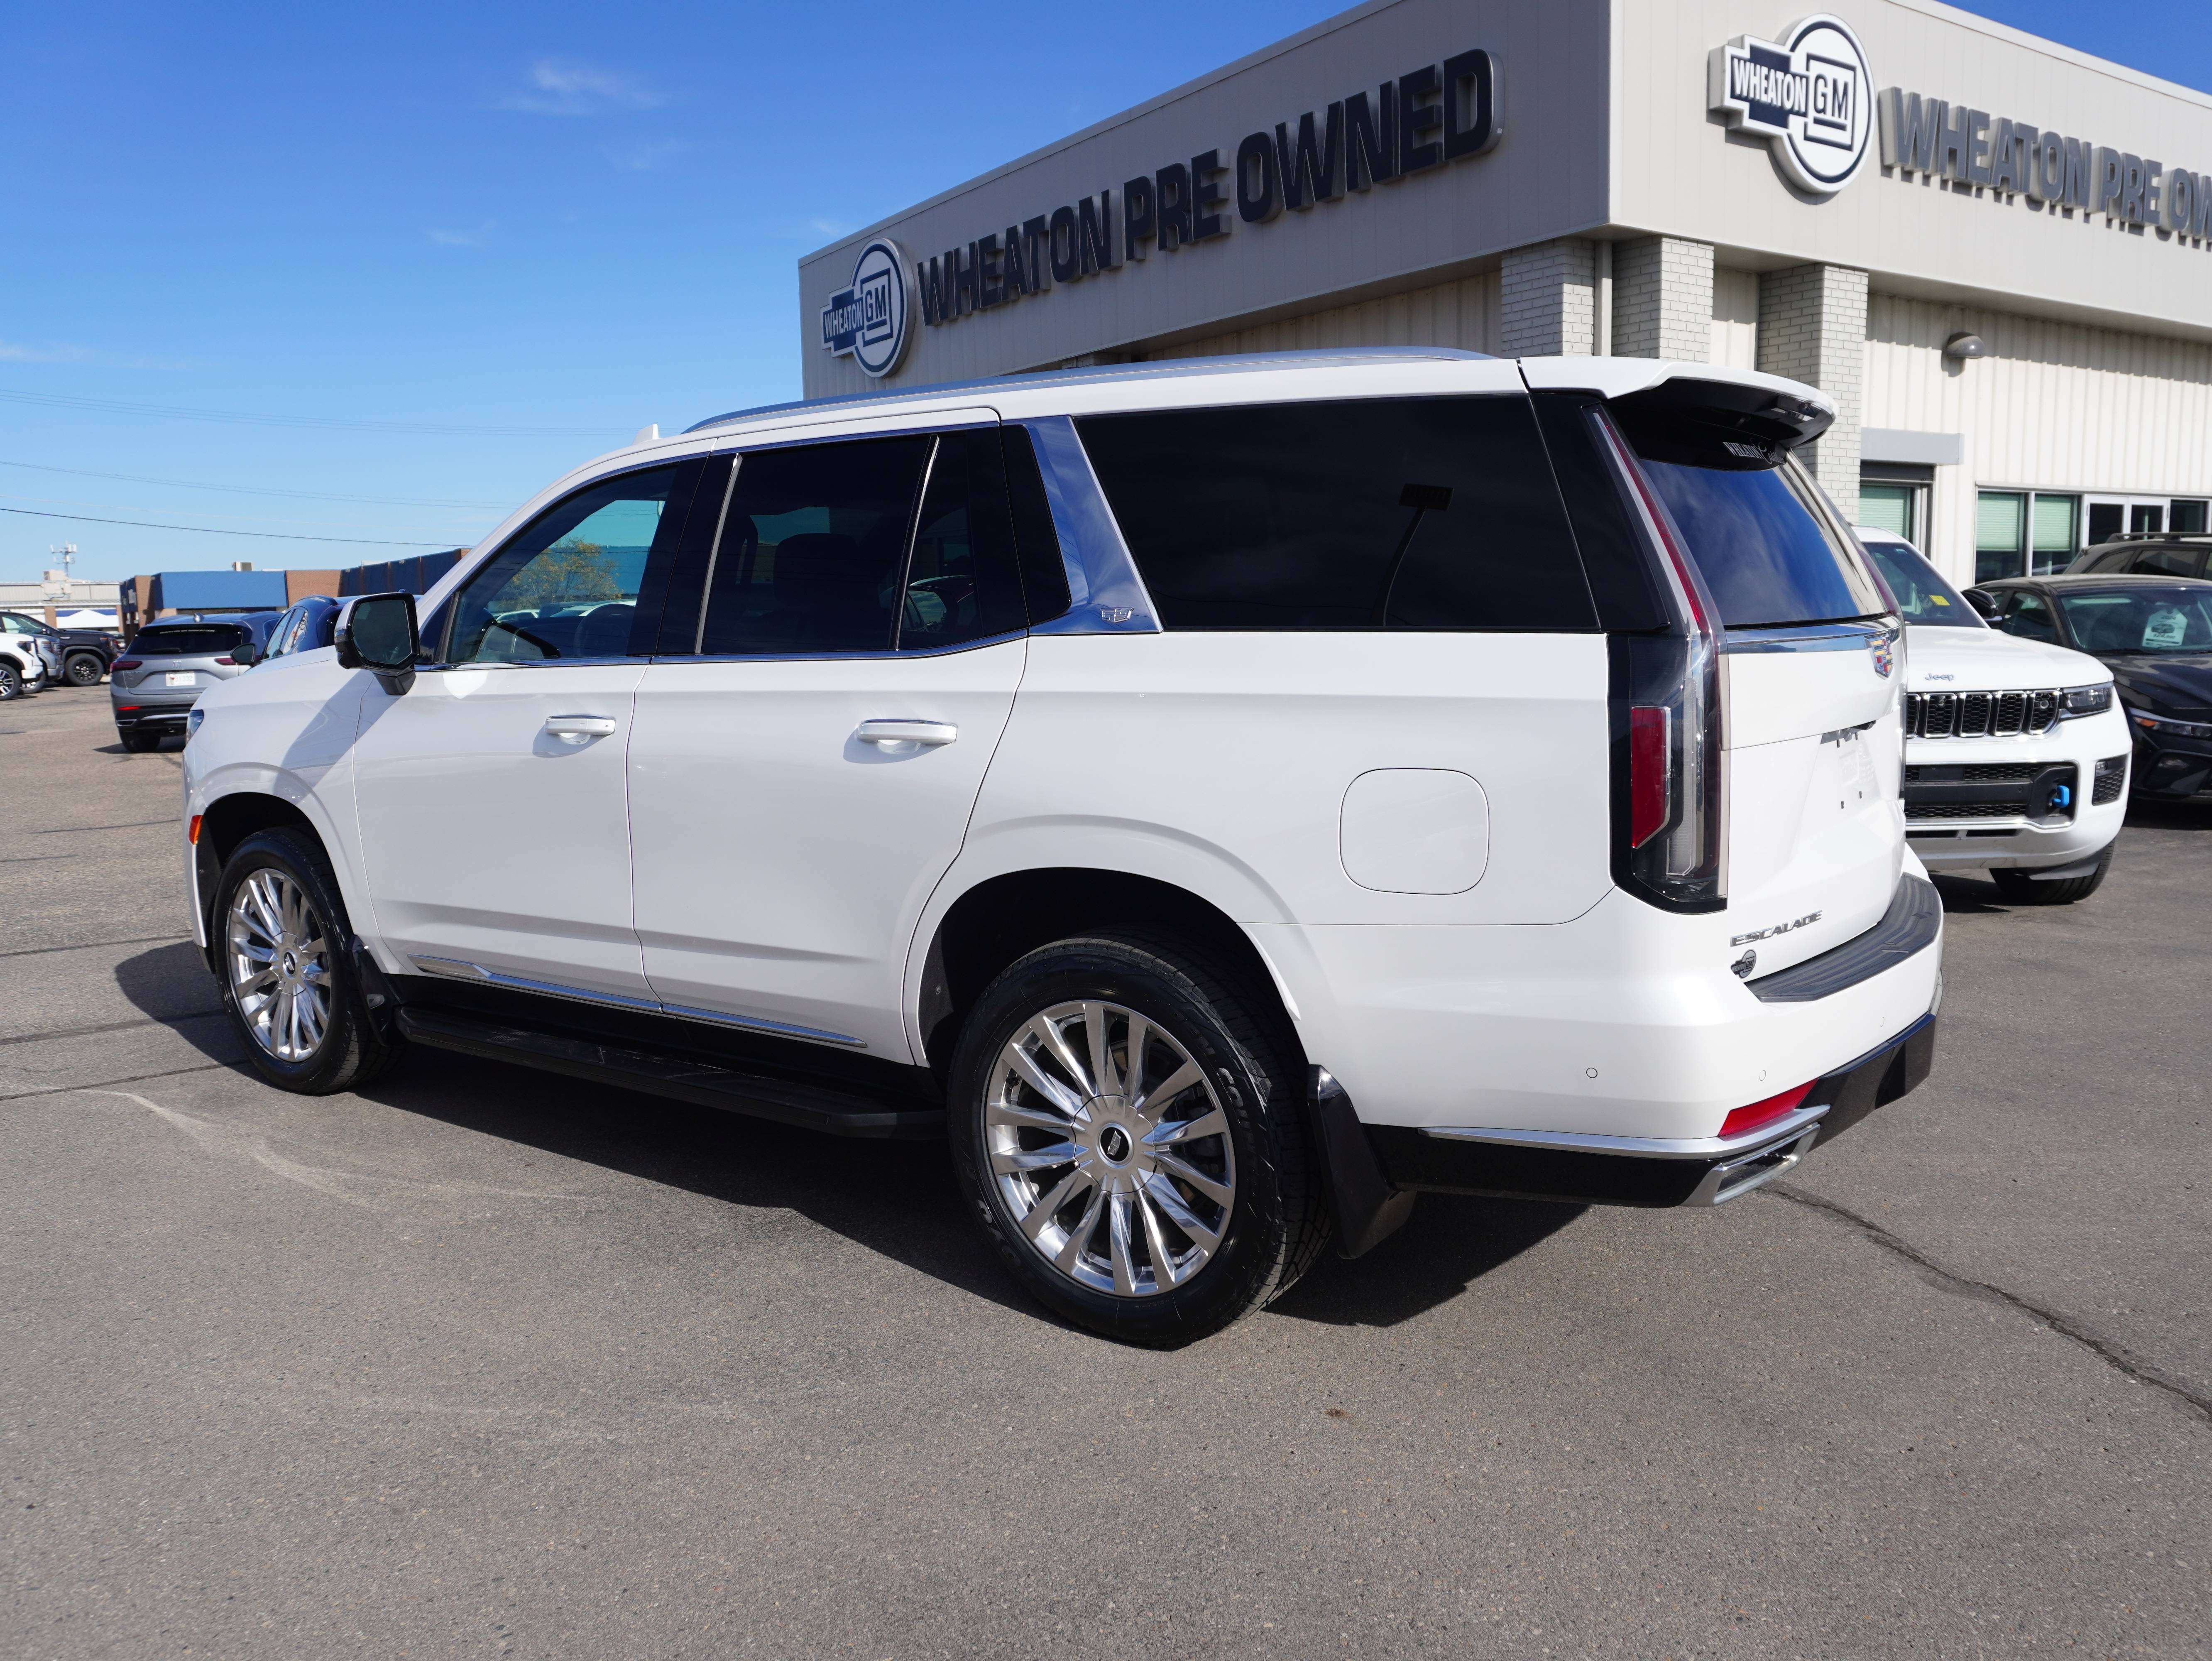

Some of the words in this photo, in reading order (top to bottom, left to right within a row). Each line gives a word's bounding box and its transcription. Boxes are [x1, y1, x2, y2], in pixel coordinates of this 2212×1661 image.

[1733, 58, 1807, 113] WHEATON
[1814, 73, 1849, 120] GM
[1888, 86, 2092, 209] WHEATON
[2097, 146, 2162, 226] PRE
[917, 189, 1117, 326] WHEATON
[1123, 148, 1226, 262] PRE
[1236, 49, 1500, 223] OWNED
[824, 300, 863, 339] WHEATON
[865, 284, 886, 323] GM
[1925, 673, 1955, 681] Jeep
[1730, 910, 1823, 947] ESCALADE
